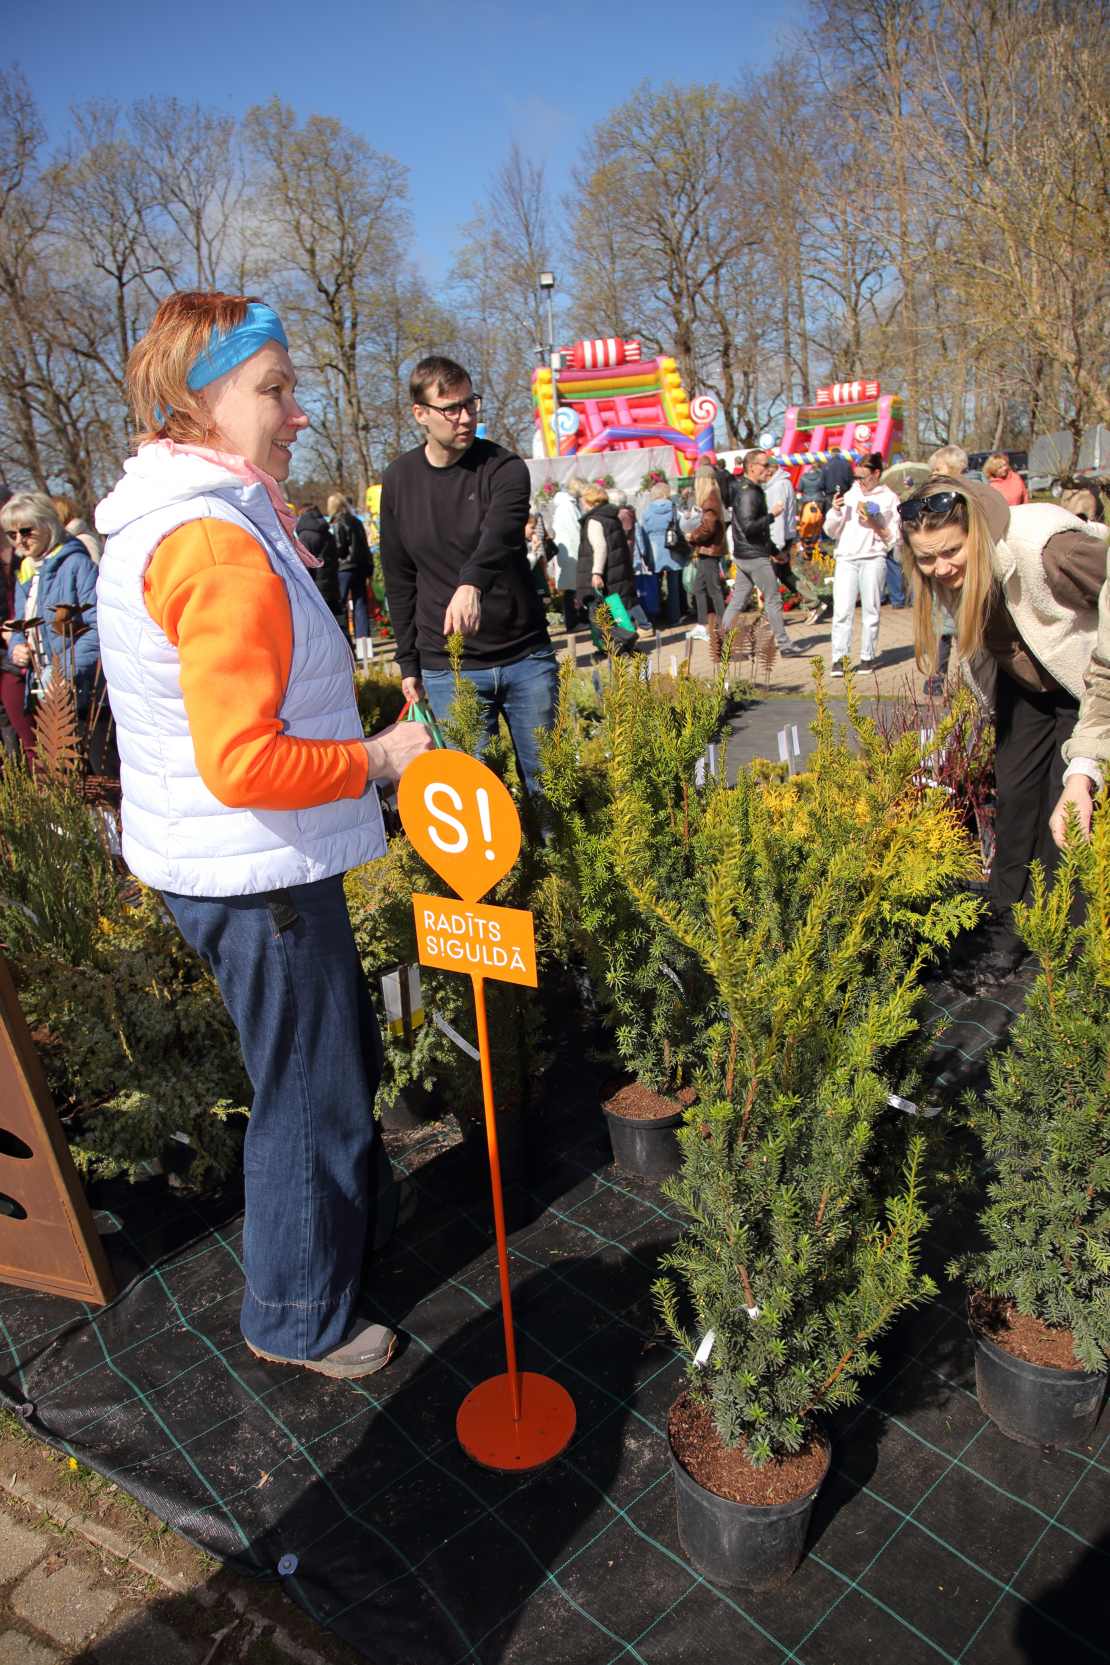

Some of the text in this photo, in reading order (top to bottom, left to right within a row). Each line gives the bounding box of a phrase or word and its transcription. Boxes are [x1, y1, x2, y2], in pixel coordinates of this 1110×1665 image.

[423, 782, 496, 861] S!
[423, 910, 502, 942] RADĪTS
[426, 935, 527, 973] S!GULDĀ
